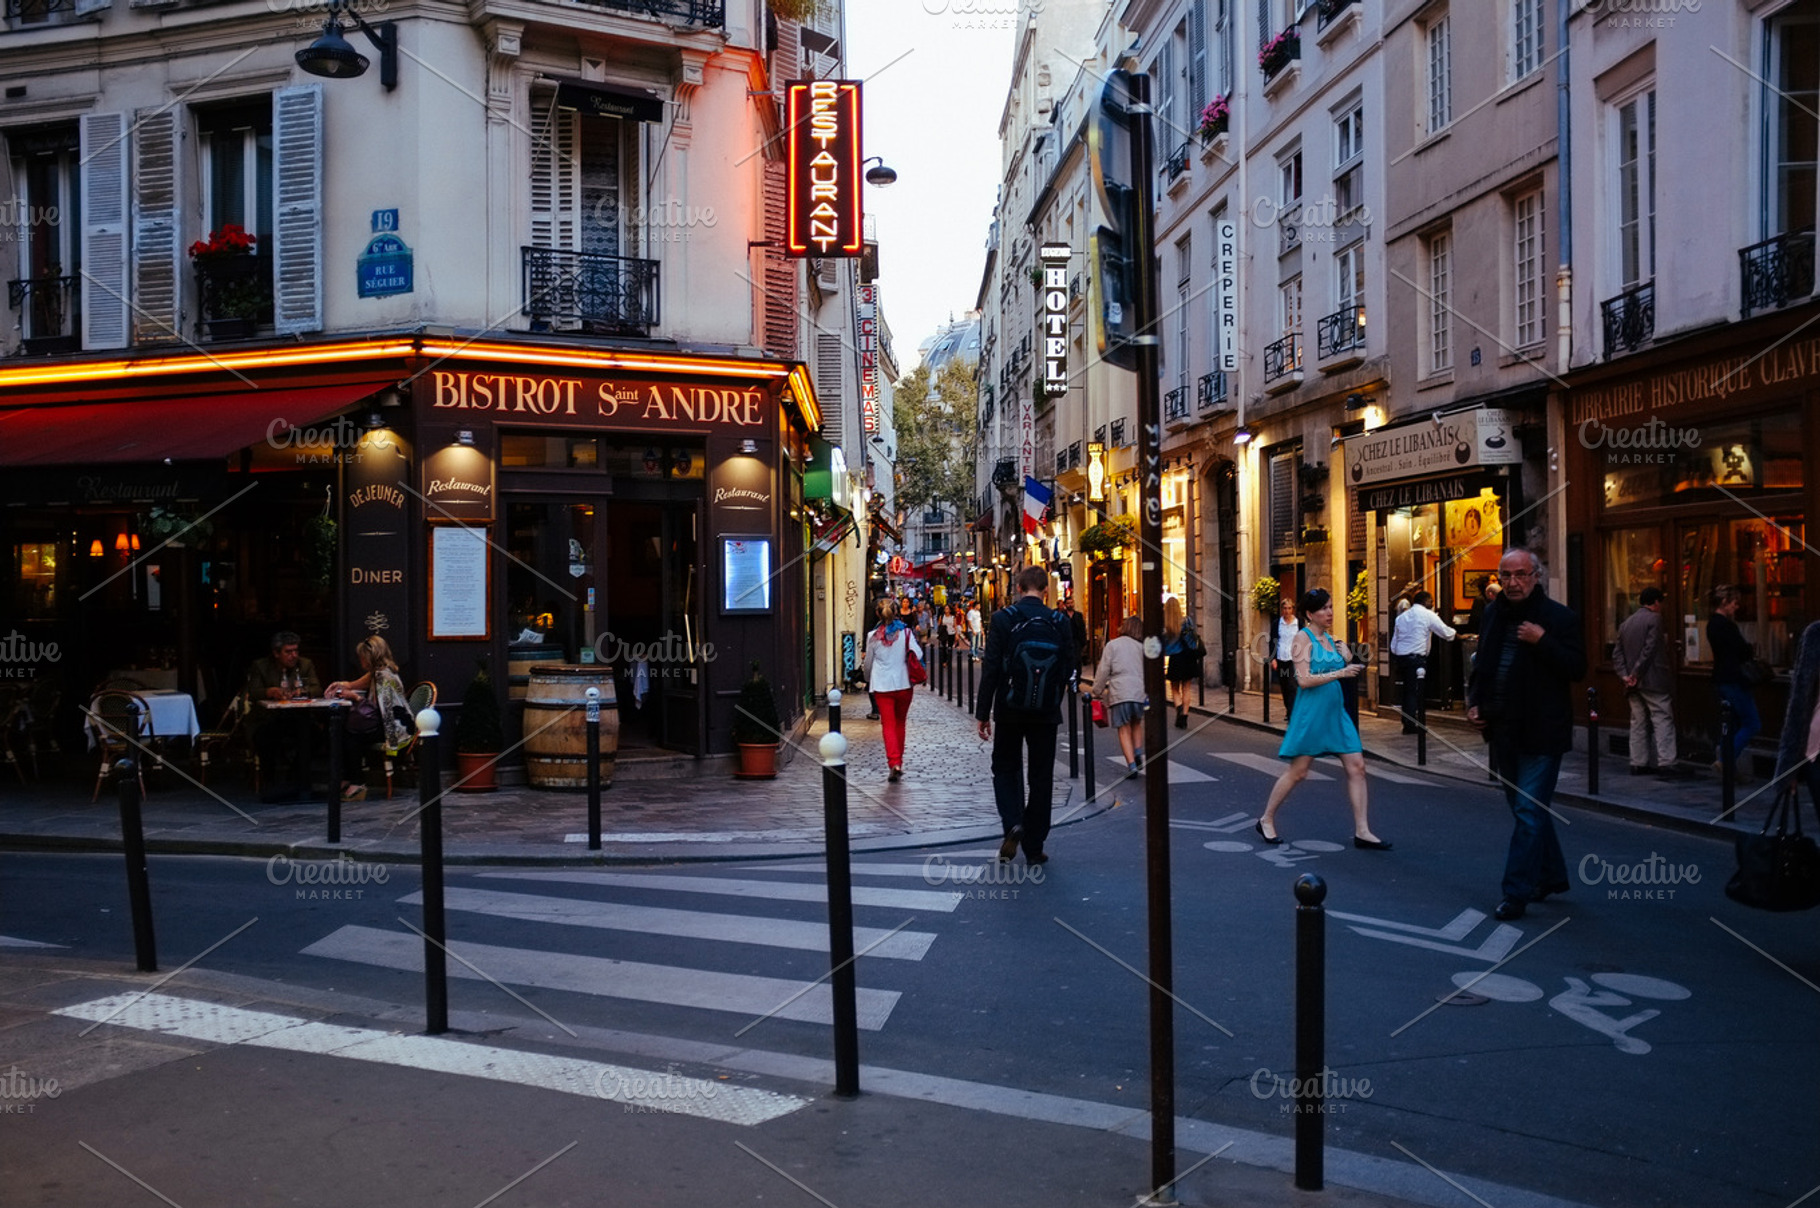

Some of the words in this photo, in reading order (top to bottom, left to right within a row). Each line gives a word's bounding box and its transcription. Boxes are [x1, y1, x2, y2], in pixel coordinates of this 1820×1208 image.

[810, 81, 839, 254] RESTAURANT
[378, 211, 393, 230] 19
[365, 276, 405, 289] SÉGUIER
[375, 265, 395, 275] RUE
[861, 288, 872, 301] 3
[1046, 268, 1066, 380] HOTEL
[861, 320, 875, 431] CINEMAS
[433, 371, 583, 415] BISTROT
[599, 381, 639, 416] Saint
[642, 385, 763, 426] ANDRÉ
[1572, 381, 1644, 425] LIBRAIRIE
[1651, 356, 1751, 409] HISTORIQUE
[1363, 440, 1387, 462] CHEZ
[1390, 437, 1401, 457] LE
[1403, 426, 1454, 454] LIBANAIS
[349, 485, 405, 509] DEJEUNER
[427, 477, 491, 496] Restaurant
[714, 486, 770, 503] Restaurant
[1369, 490, 1394, 509] CHEZ
[1399, 487, 1411, 504] LE
[1415, 479, 1465, 502] LIBANAIS
